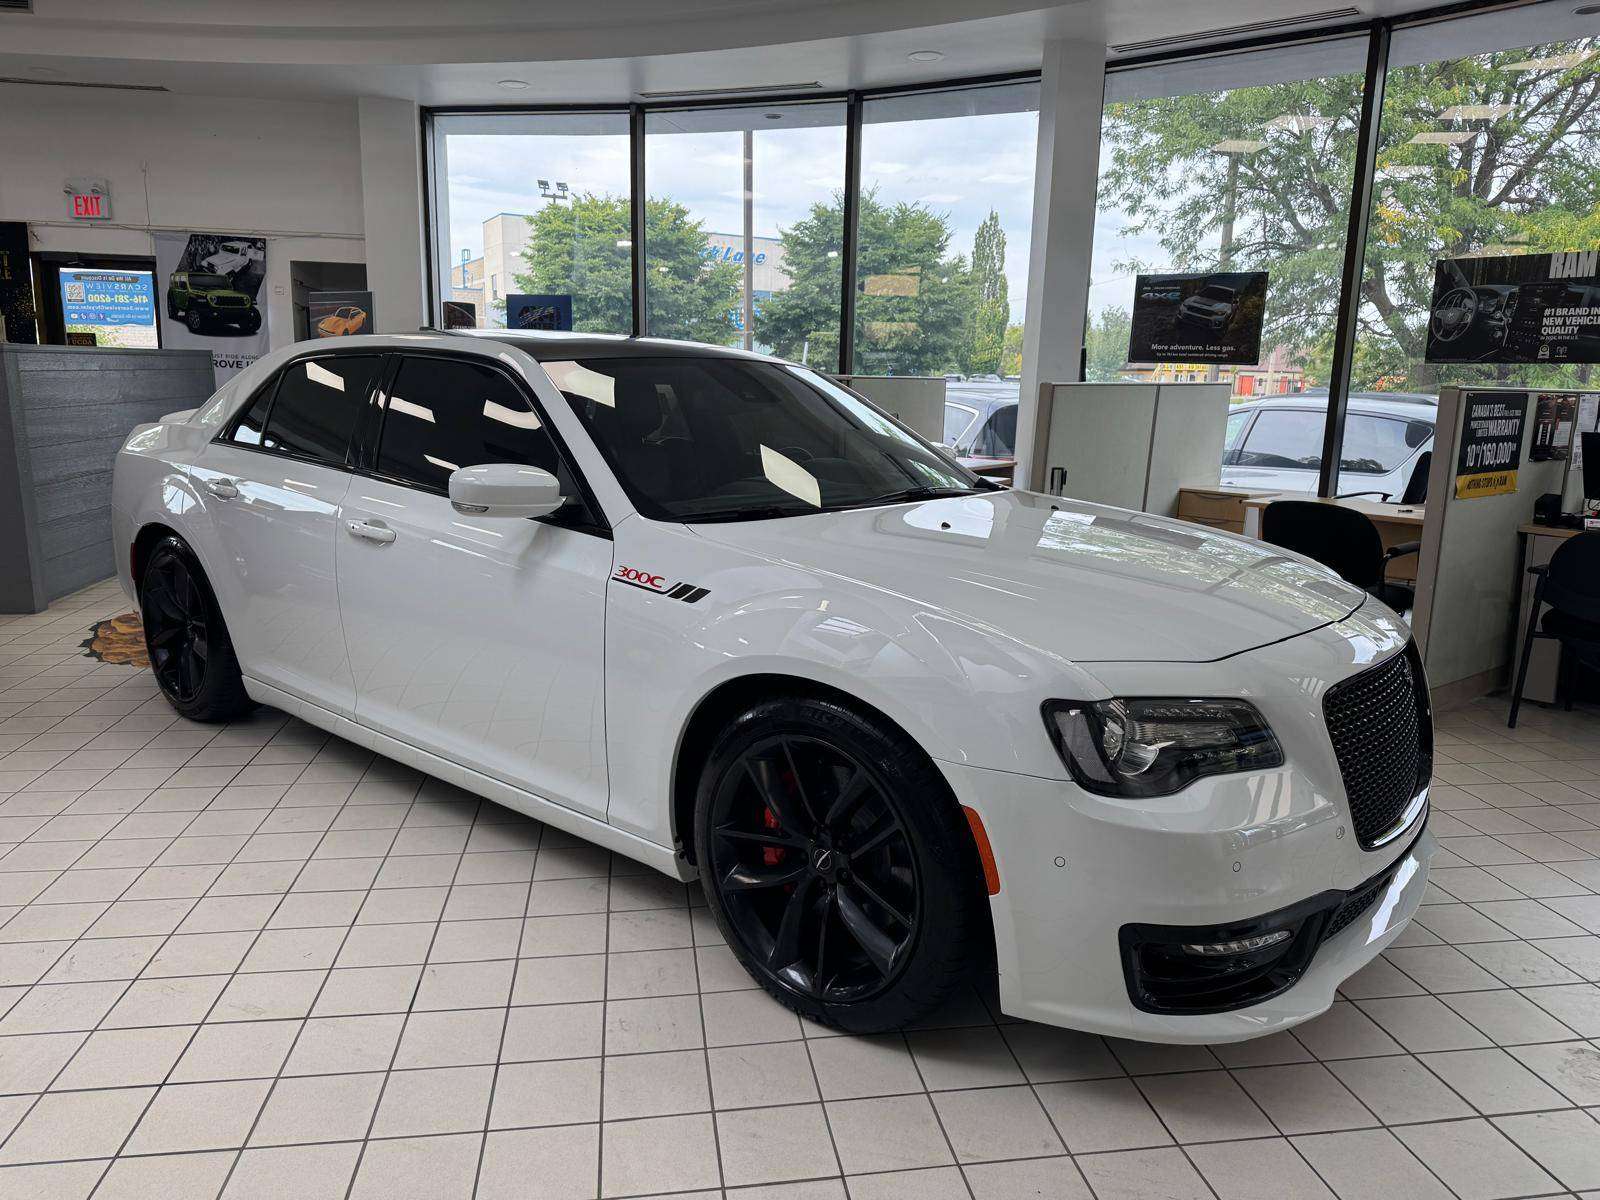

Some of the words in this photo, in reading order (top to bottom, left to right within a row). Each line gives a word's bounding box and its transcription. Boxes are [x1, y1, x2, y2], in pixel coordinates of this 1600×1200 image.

[74, 195, 101, 216] EXIT
[1548, 250, 1599, 279] RAM
[1544, 307, 1555, 316] #1
[1556, 307, 1590, 316] BRAND
[1542, 316, 1564, 326] NEW
[1541, 326, 1579, 335] QUALITY
[1151, 343, 1169, 351] More
[1471, 404, 1494, 418] CANADA'S
[1494, 403, 1506, 417] BEST
[1488, 418, 1521, 437] WARRANTY
[614, 565, 666, 588] 300C
